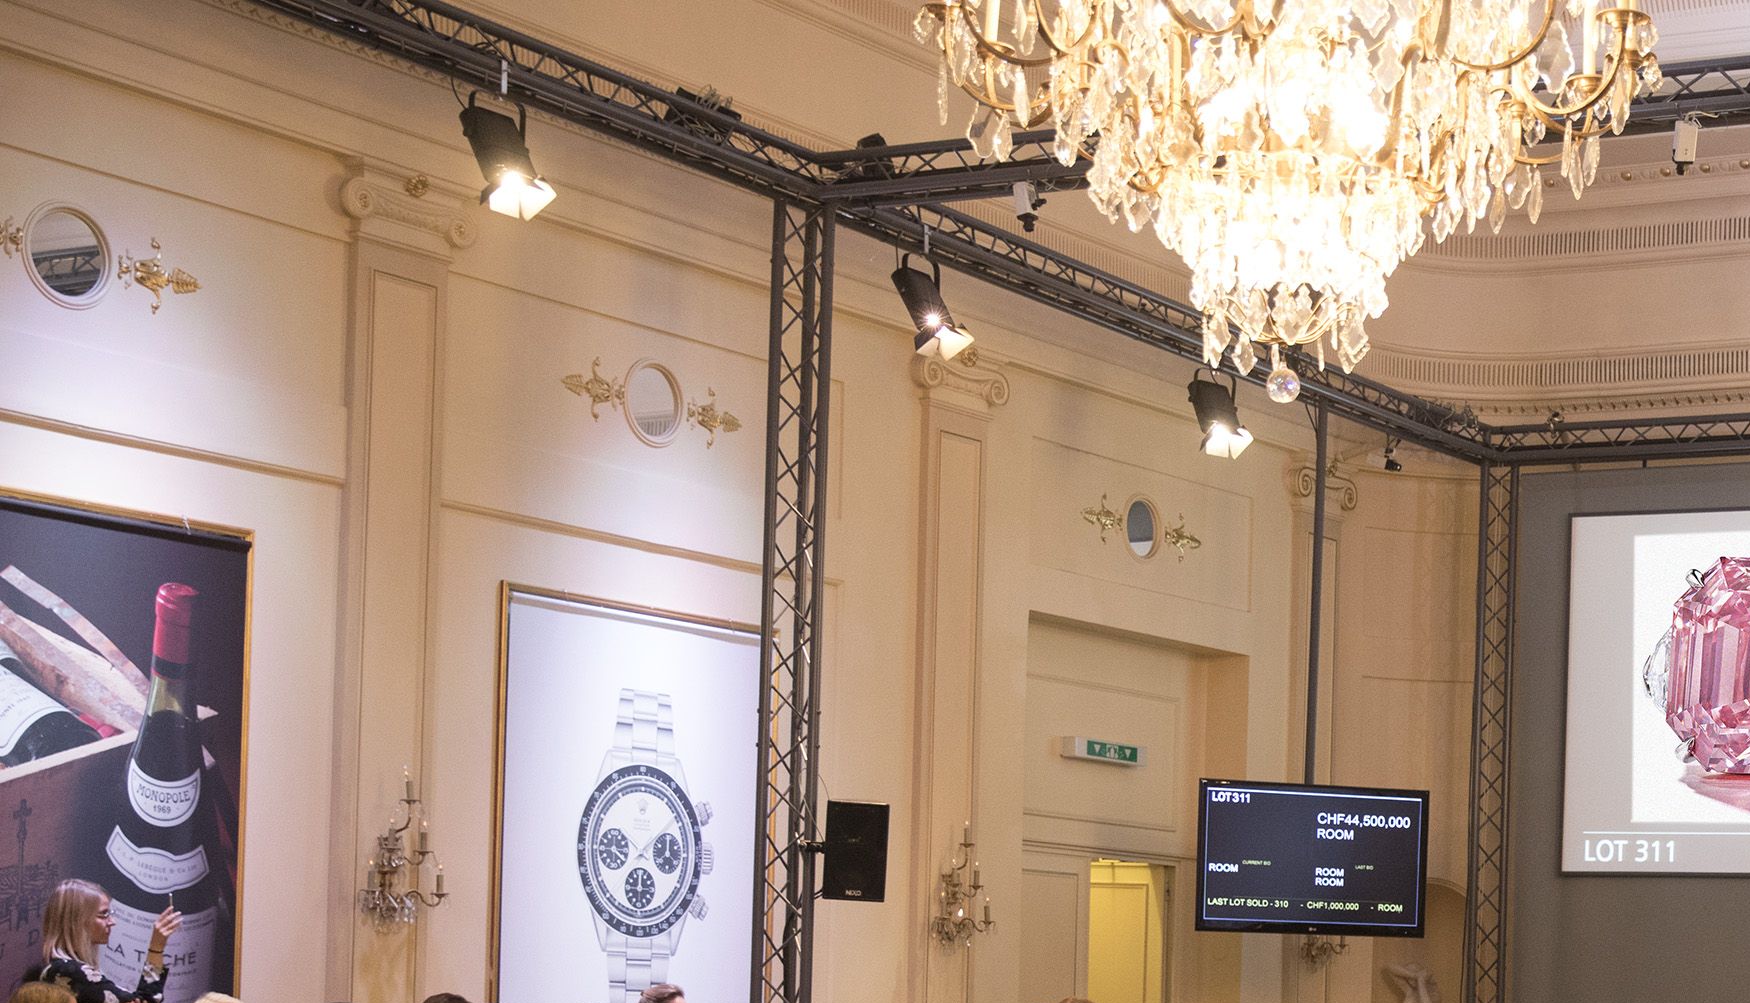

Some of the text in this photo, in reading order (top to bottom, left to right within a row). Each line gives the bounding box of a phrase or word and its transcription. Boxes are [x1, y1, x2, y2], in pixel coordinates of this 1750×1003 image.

[136, 784, 191, 804] MONOPOLE
[153, 805, 171, 814] 1969
[1317, 812, 1411, 829] CHF44,500,000
[1316, 828, 1354, 840] ROOM
[1584, 839, 1676, 863] LOT 311
[1208, 863, 1239, 872] ROOM
[1315, 867, 1344, 877] ROOM
[1315, 877, 1344, 887] ROOM
[1229, 898, 1245, 906] LOT
[1247, 899, 1268, 907] SOLD
[1274, 900, 1288, 908] 310
[1307, 901, 1359, 910] CHF1,000,000
[1377, 904, 1403, 913] ROOM
